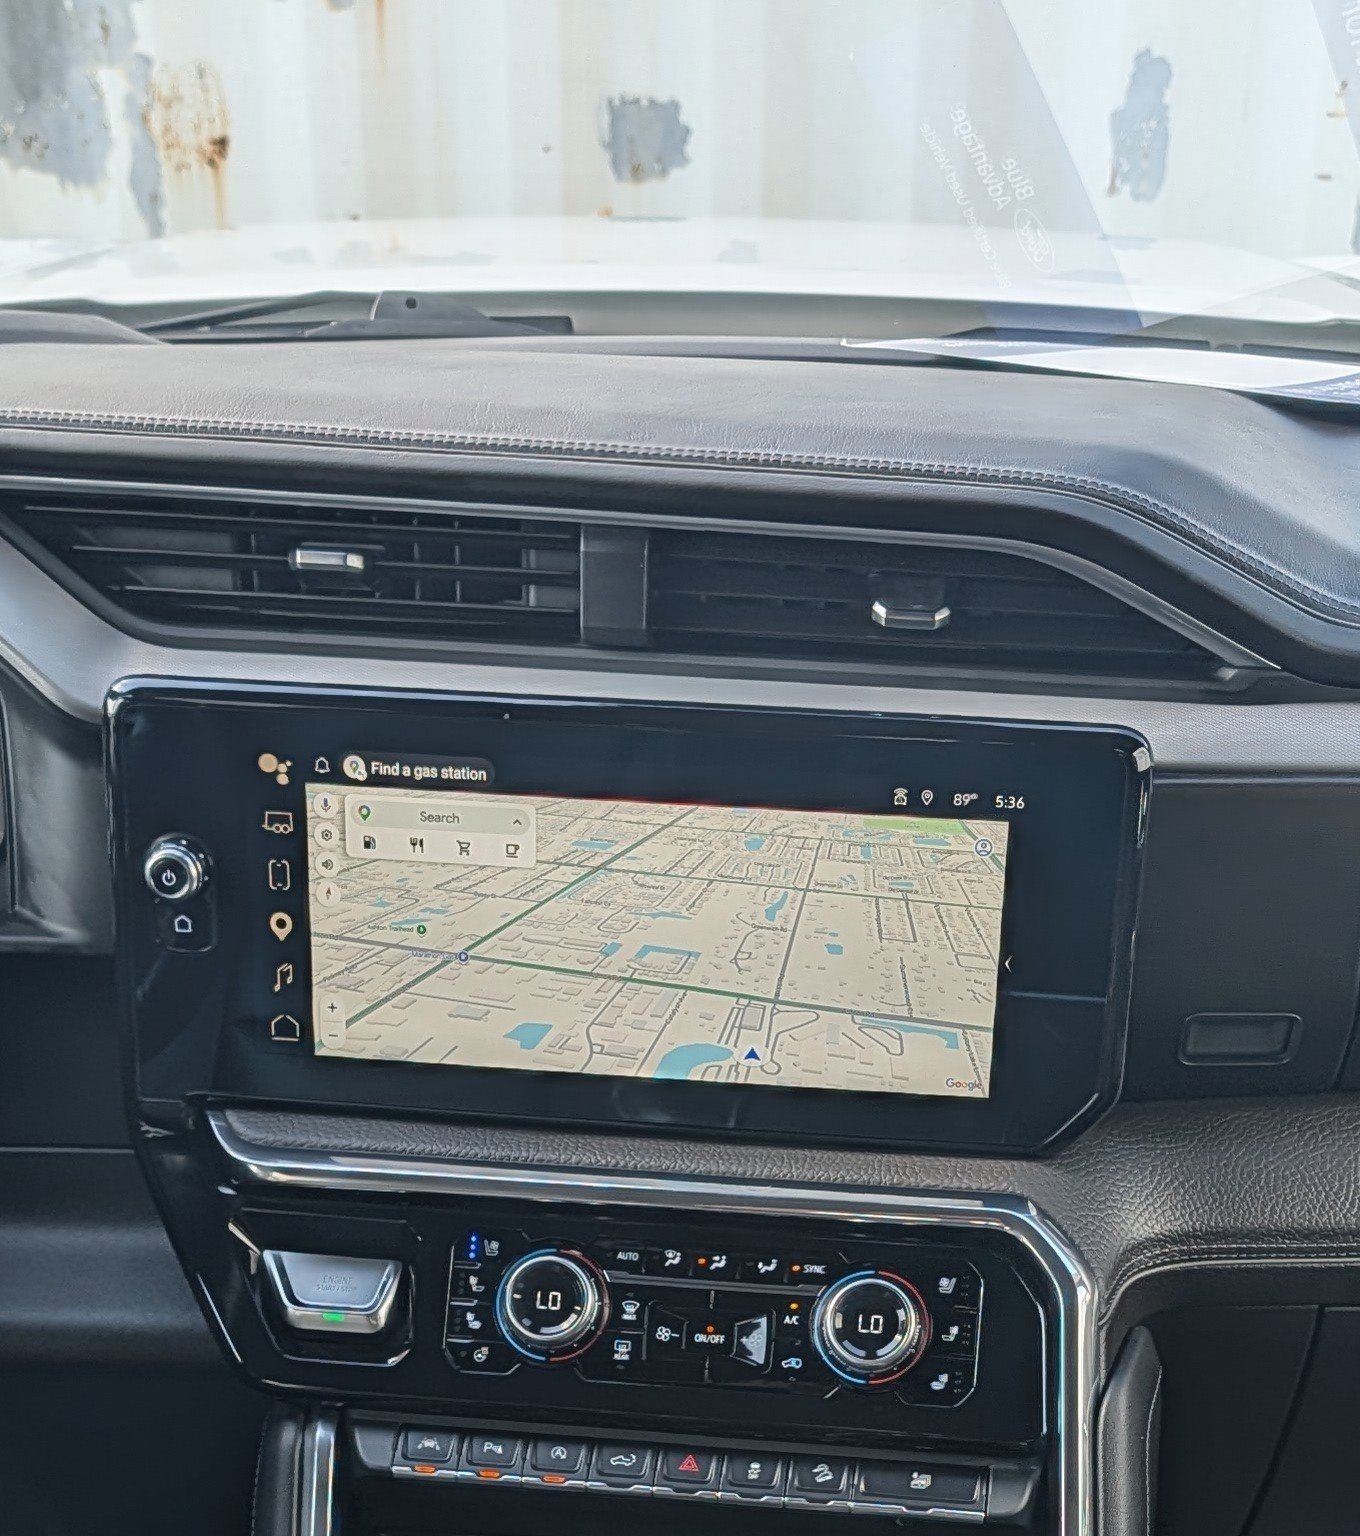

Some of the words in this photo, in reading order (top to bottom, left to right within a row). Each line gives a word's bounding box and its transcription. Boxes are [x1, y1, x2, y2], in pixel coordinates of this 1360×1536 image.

[371, 761, 400, 777] Find
[402, 768, 411, 777] a
[414, 767, 438, 781] gas
[440, 766, 488, 782] station
[995, 795, 1026, 809] 5:36
[419, 810, 461, 825] Search
[946, 1077, 983, 1092] Google
[617, 1251, 639, 1262] AUTO
[803, 1264, 827, 1274] SYNC
[536, 1290, 562, 1311] LO
[783, 1315, 800, 1326] A/C
[858, 1314, 884, 1334] LO
[694, 1333, 725, 1345] ON/OFF
